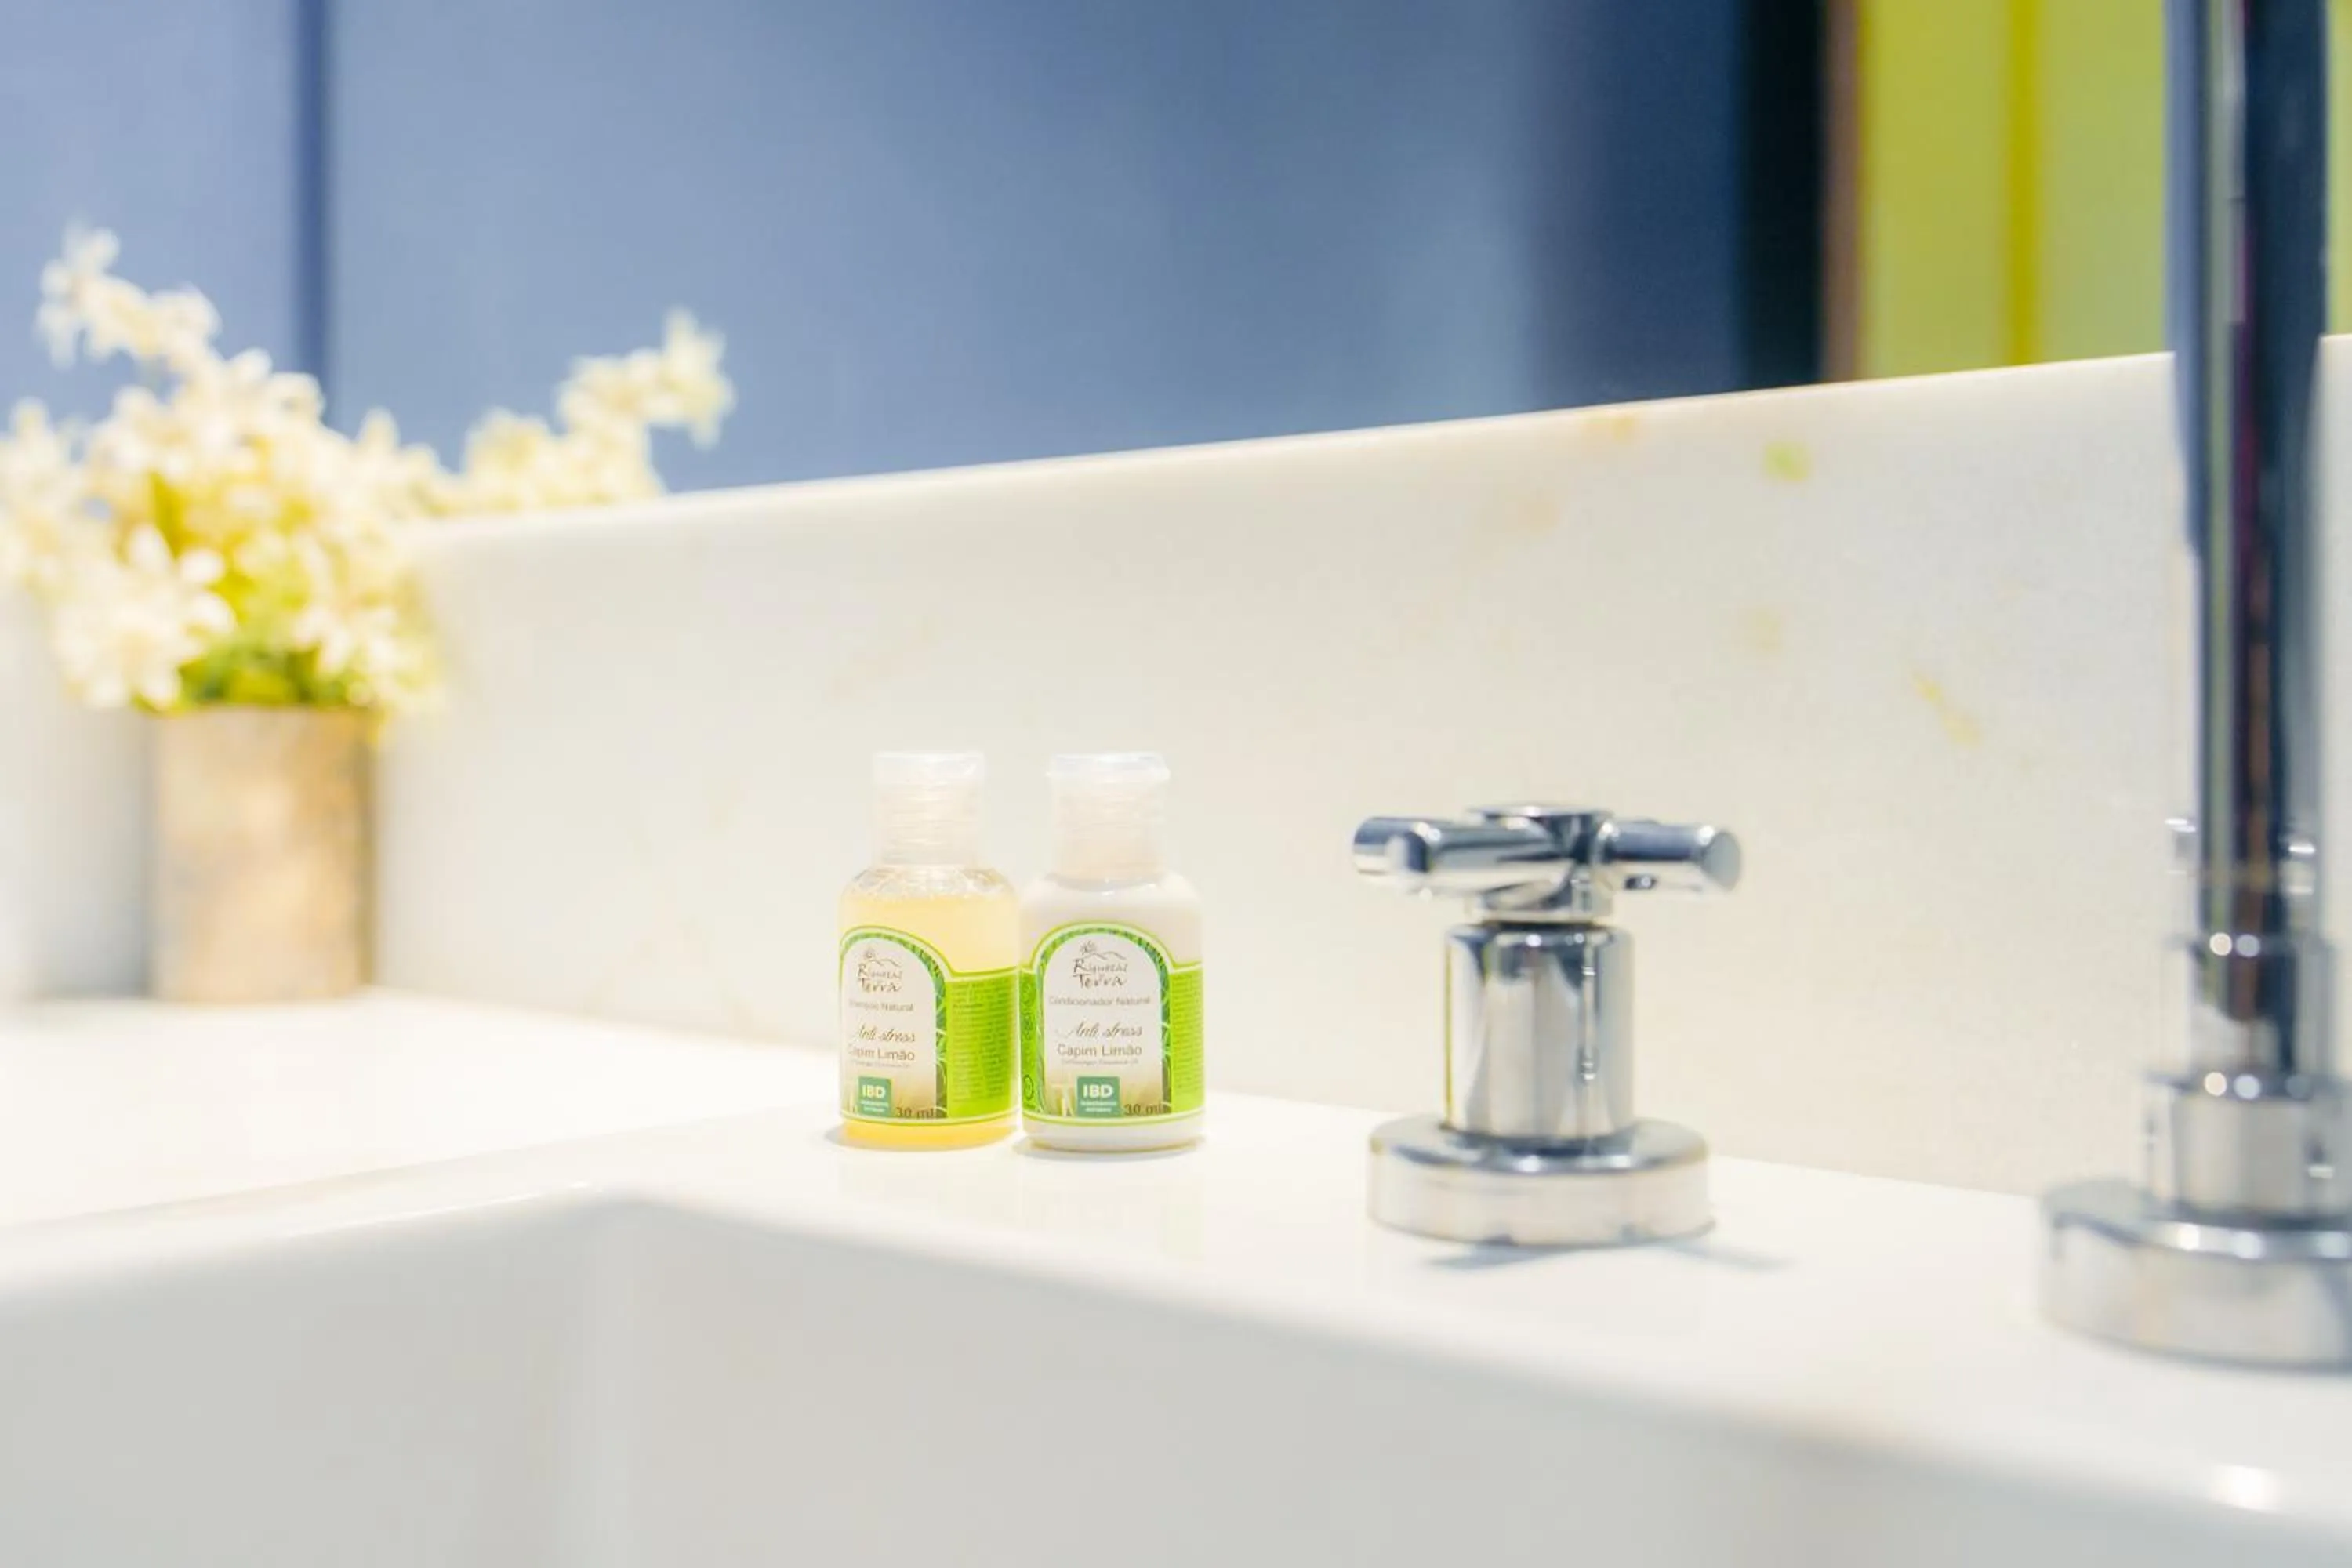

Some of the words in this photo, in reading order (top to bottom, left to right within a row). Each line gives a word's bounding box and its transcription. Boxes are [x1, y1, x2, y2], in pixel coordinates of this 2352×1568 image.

[1072, 973, 1129, 989] Terra
[1116, 996, 1151, 1006] Natural
[877, 1048, 916, 1061] Limão
[1057, 1043, 1098, 1058] Capim
[1102, 1043, 1142, 1057] Limão
[862, 1083, 886, 1099] IBD
[1082, 1083, 1114, 1098] IBD
[895, 1106, 913, 1119] 30
[1123, 1103, 1142, 1116] 30
